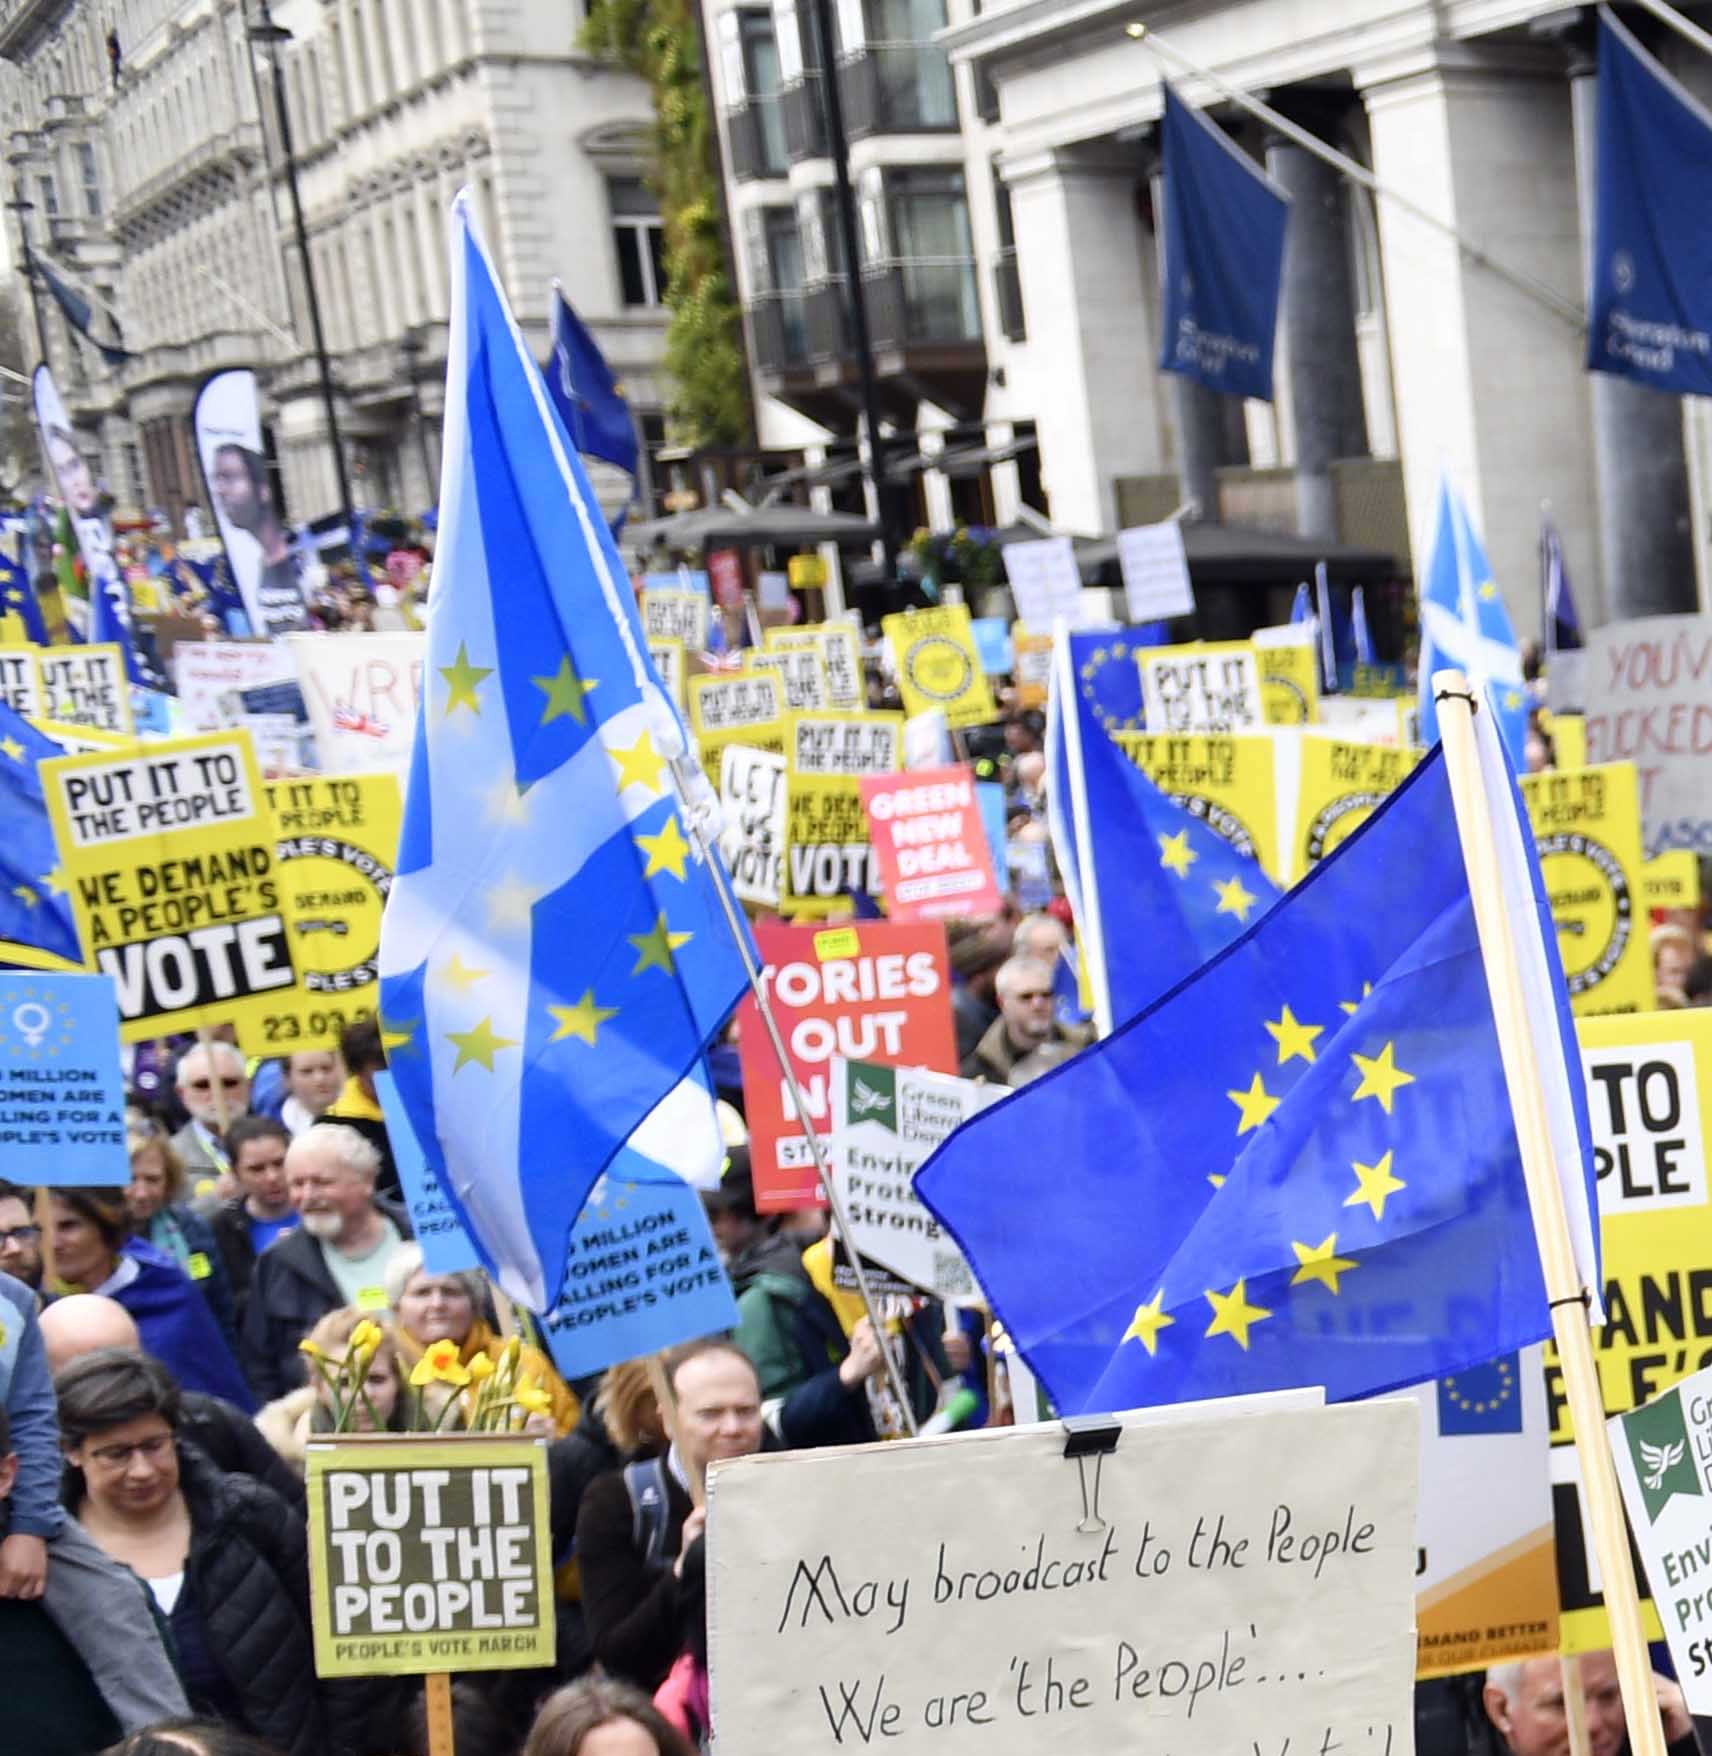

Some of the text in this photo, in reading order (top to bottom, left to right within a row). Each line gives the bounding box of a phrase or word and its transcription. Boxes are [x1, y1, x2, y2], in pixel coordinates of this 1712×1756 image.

[65, 753, 237, 812] PUT IT TO
[870, 781, 972, 820] GREEN
[72, 788, 245, 844] THE PEOPLE
[891, 812, 964, 848] NEW
[77, 845, 270, 912] WE DEMAND
[899, 842, 972, 877] DEAL
[114, 878, 280, 935] PEOPLE'S
[96, 914, 295, 1020] VOTE
[583, 1210, 676, 1251] MILLION
[646, 1229, 690, 1254] ARE
[662, 1270, 721, 1299] VOTE
[329, 1468, 530, 1532] PUT IT
[331, 1527, 533, 1586] TO THE
[777, 1504, 1377, 1636] May broadcast to the People
[332, 1579, 537, 1636] PEOPLE
[335, 1631, 539, 1662] PEOPLE'S VOTE MARCH
[819, 1677, 904, 1745] We
[923, 1688, 997, 1729] are
